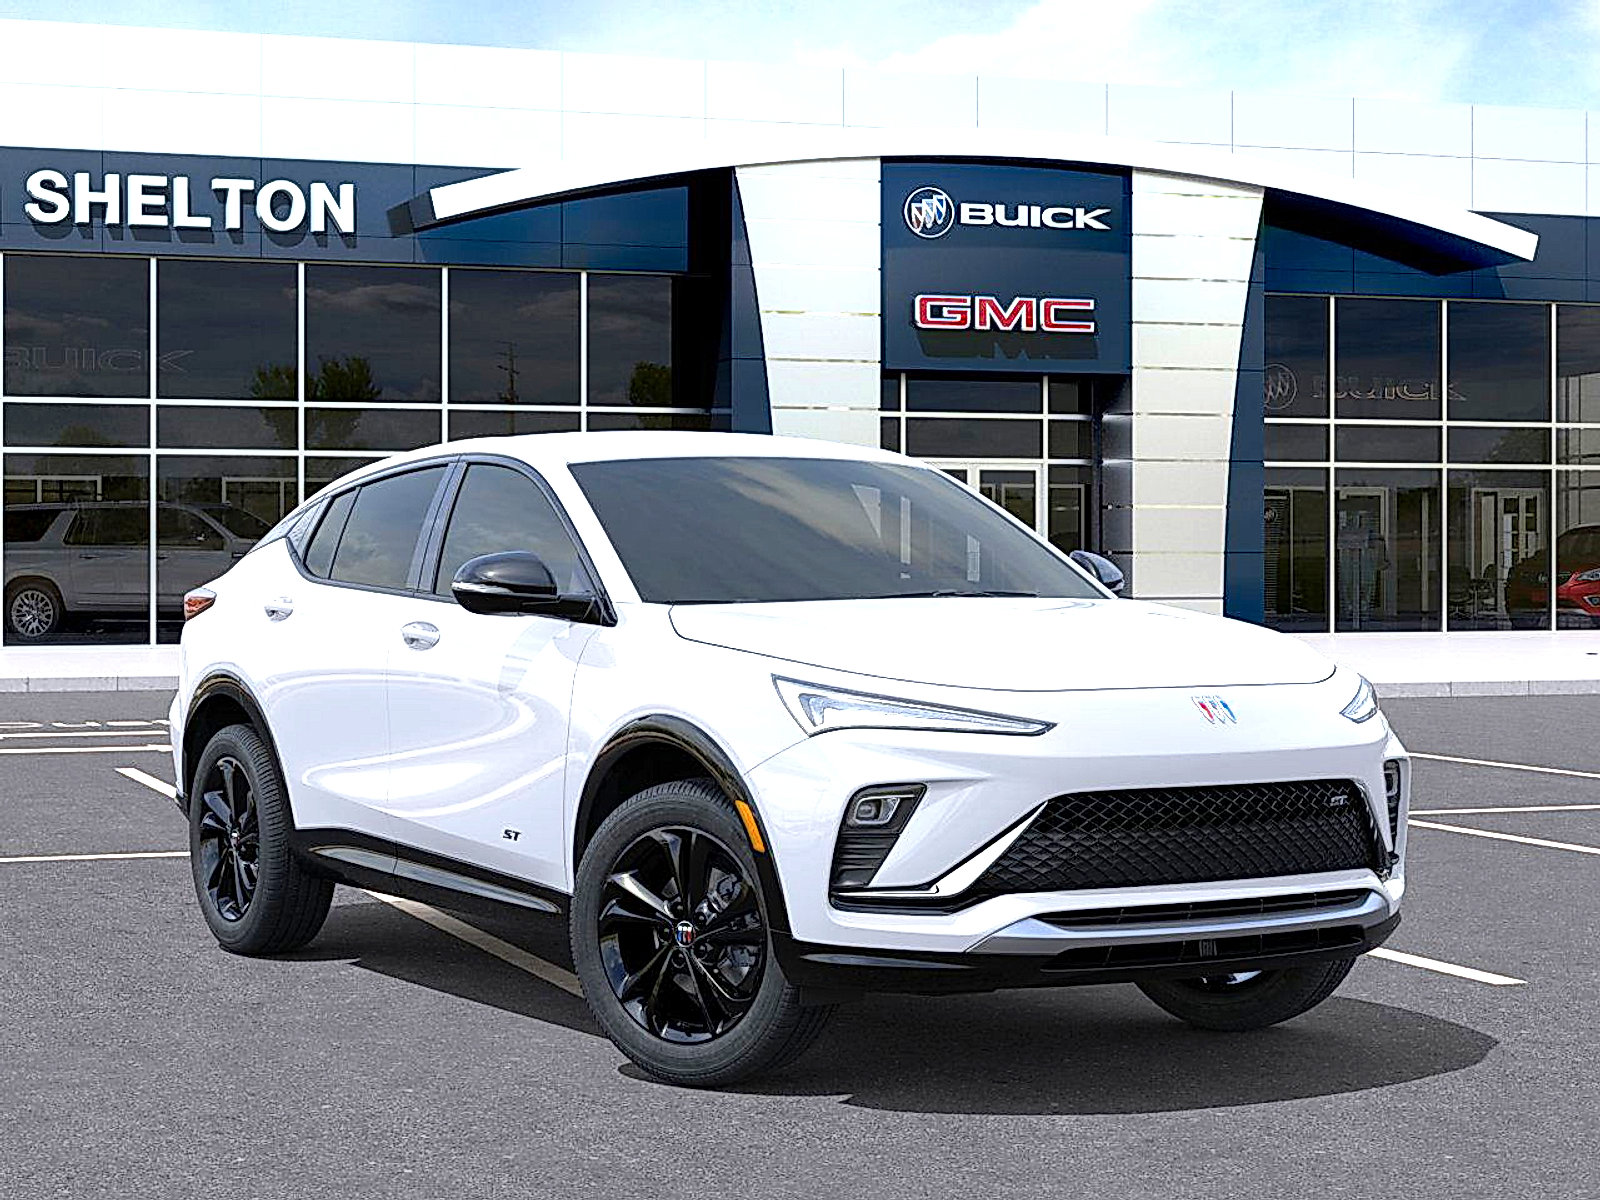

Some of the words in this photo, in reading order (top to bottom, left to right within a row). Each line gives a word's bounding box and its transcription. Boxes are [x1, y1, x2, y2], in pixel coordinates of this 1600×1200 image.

[25, 169, 355, 234] SHELTON
[960, 202, 1112, 231] BUICK
[914, 294, 1095, 332] GMC
[502, 828, 521, 841] ST
